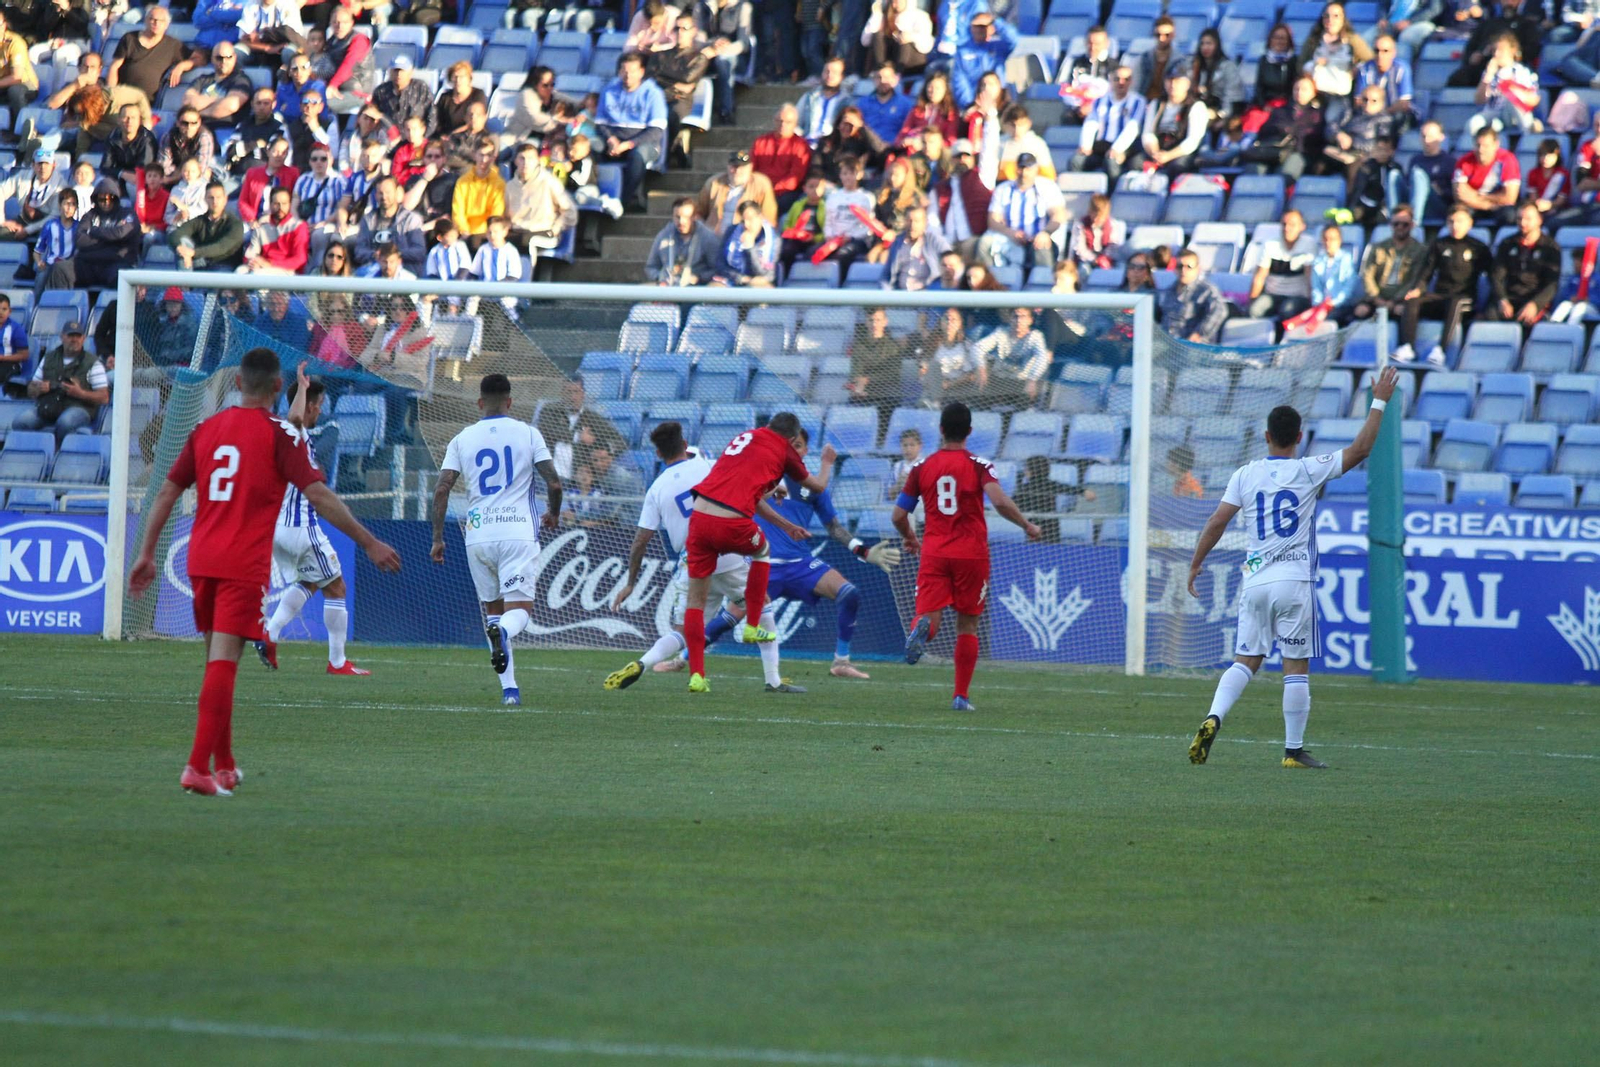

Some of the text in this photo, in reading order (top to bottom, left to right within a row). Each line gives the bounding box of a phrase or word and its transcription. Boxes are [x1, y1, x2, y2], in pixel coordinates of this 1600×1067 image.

[724, 433, 753, 456] 9
[209, 445, 240, 501] 2
[475, 445, 513, 496] 21
[937, 475, 957, 515] 8
[483, 515, 527, 524] de Huelva
[1256, 490, 1299, 541] 16
[1352, 510, 1600, 538] RCREATIVIS
[0, 539, 93, 583] KIA
[1272, 551, 1307, 563] Huelva
[6, 610, 82, 627] VEYSER
